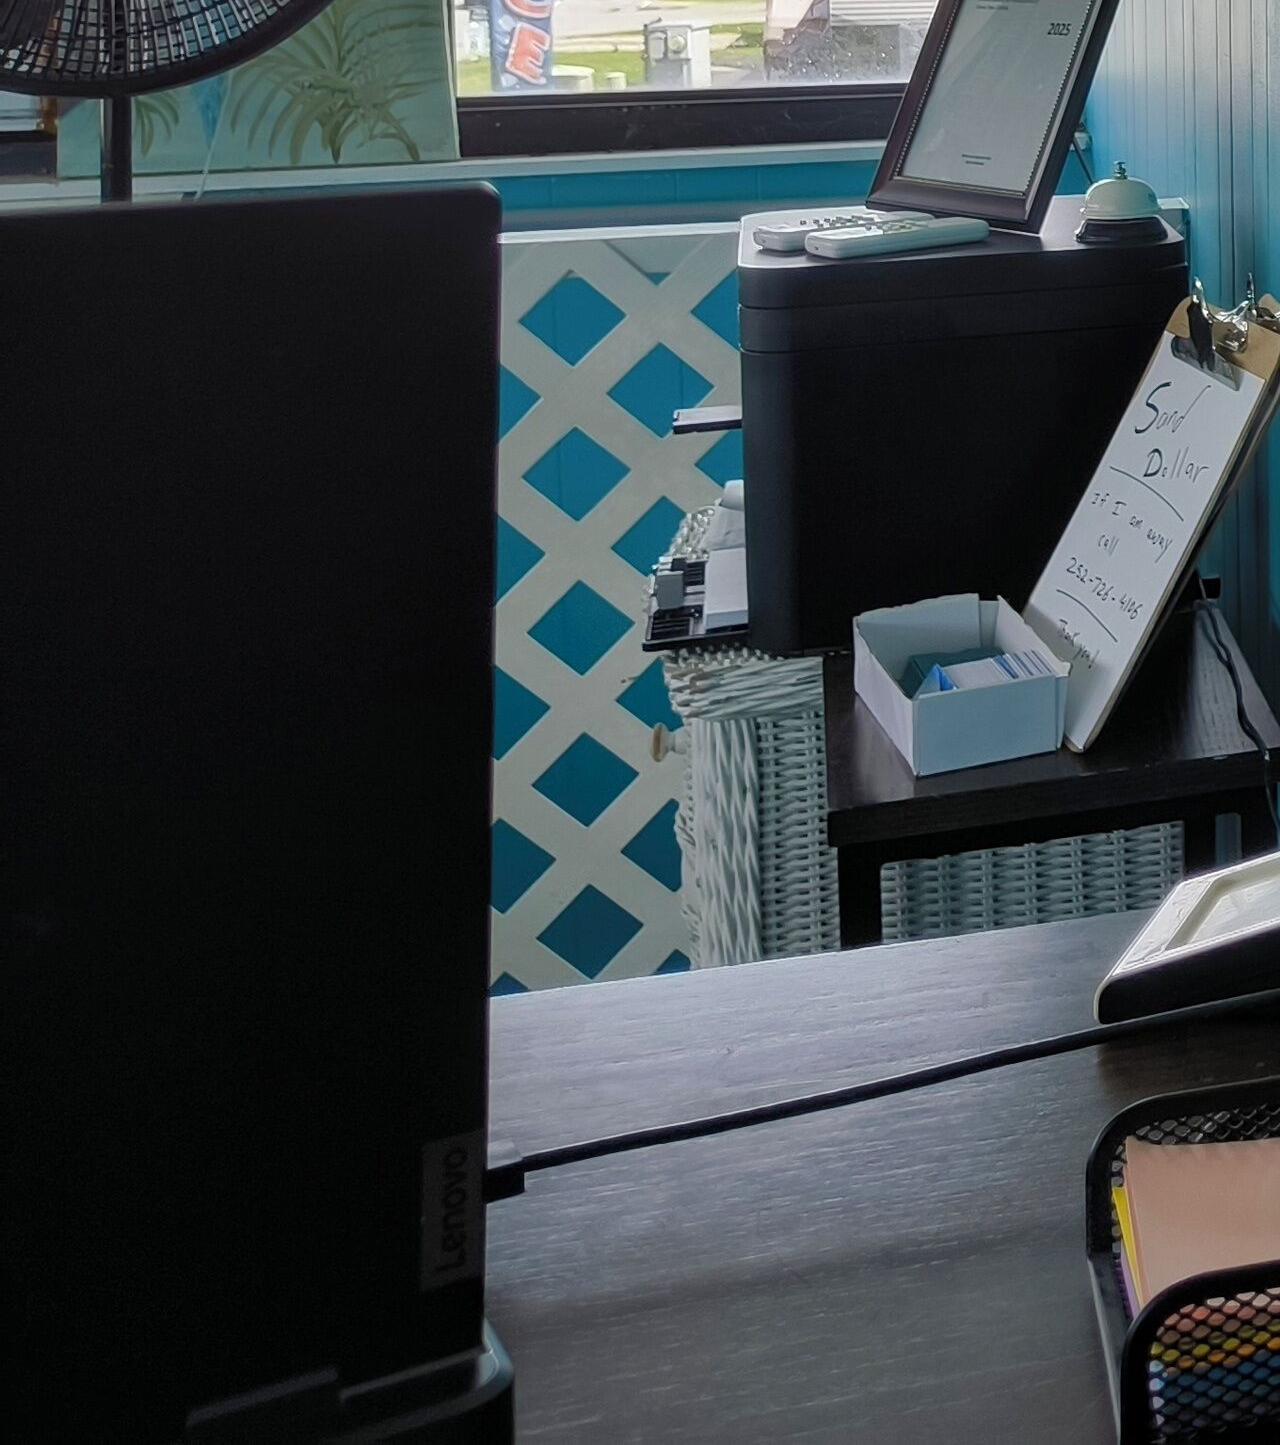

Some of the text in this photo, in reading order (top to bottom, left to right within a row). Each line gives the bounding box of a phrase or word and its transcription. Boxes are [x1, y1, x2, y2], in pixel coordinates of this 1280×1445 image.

[1047, 22, 1072, 36] 2025
[1134, 381, 1212, 434] Sand
[1143, 446, 1210, 483] Dollar
[1098, 534, 1120, 557] call
[1111, 500, 1128, 516] I
[1146, 528, 1173, 564] away
[432, 1146, 468, 1274] Lenovo
